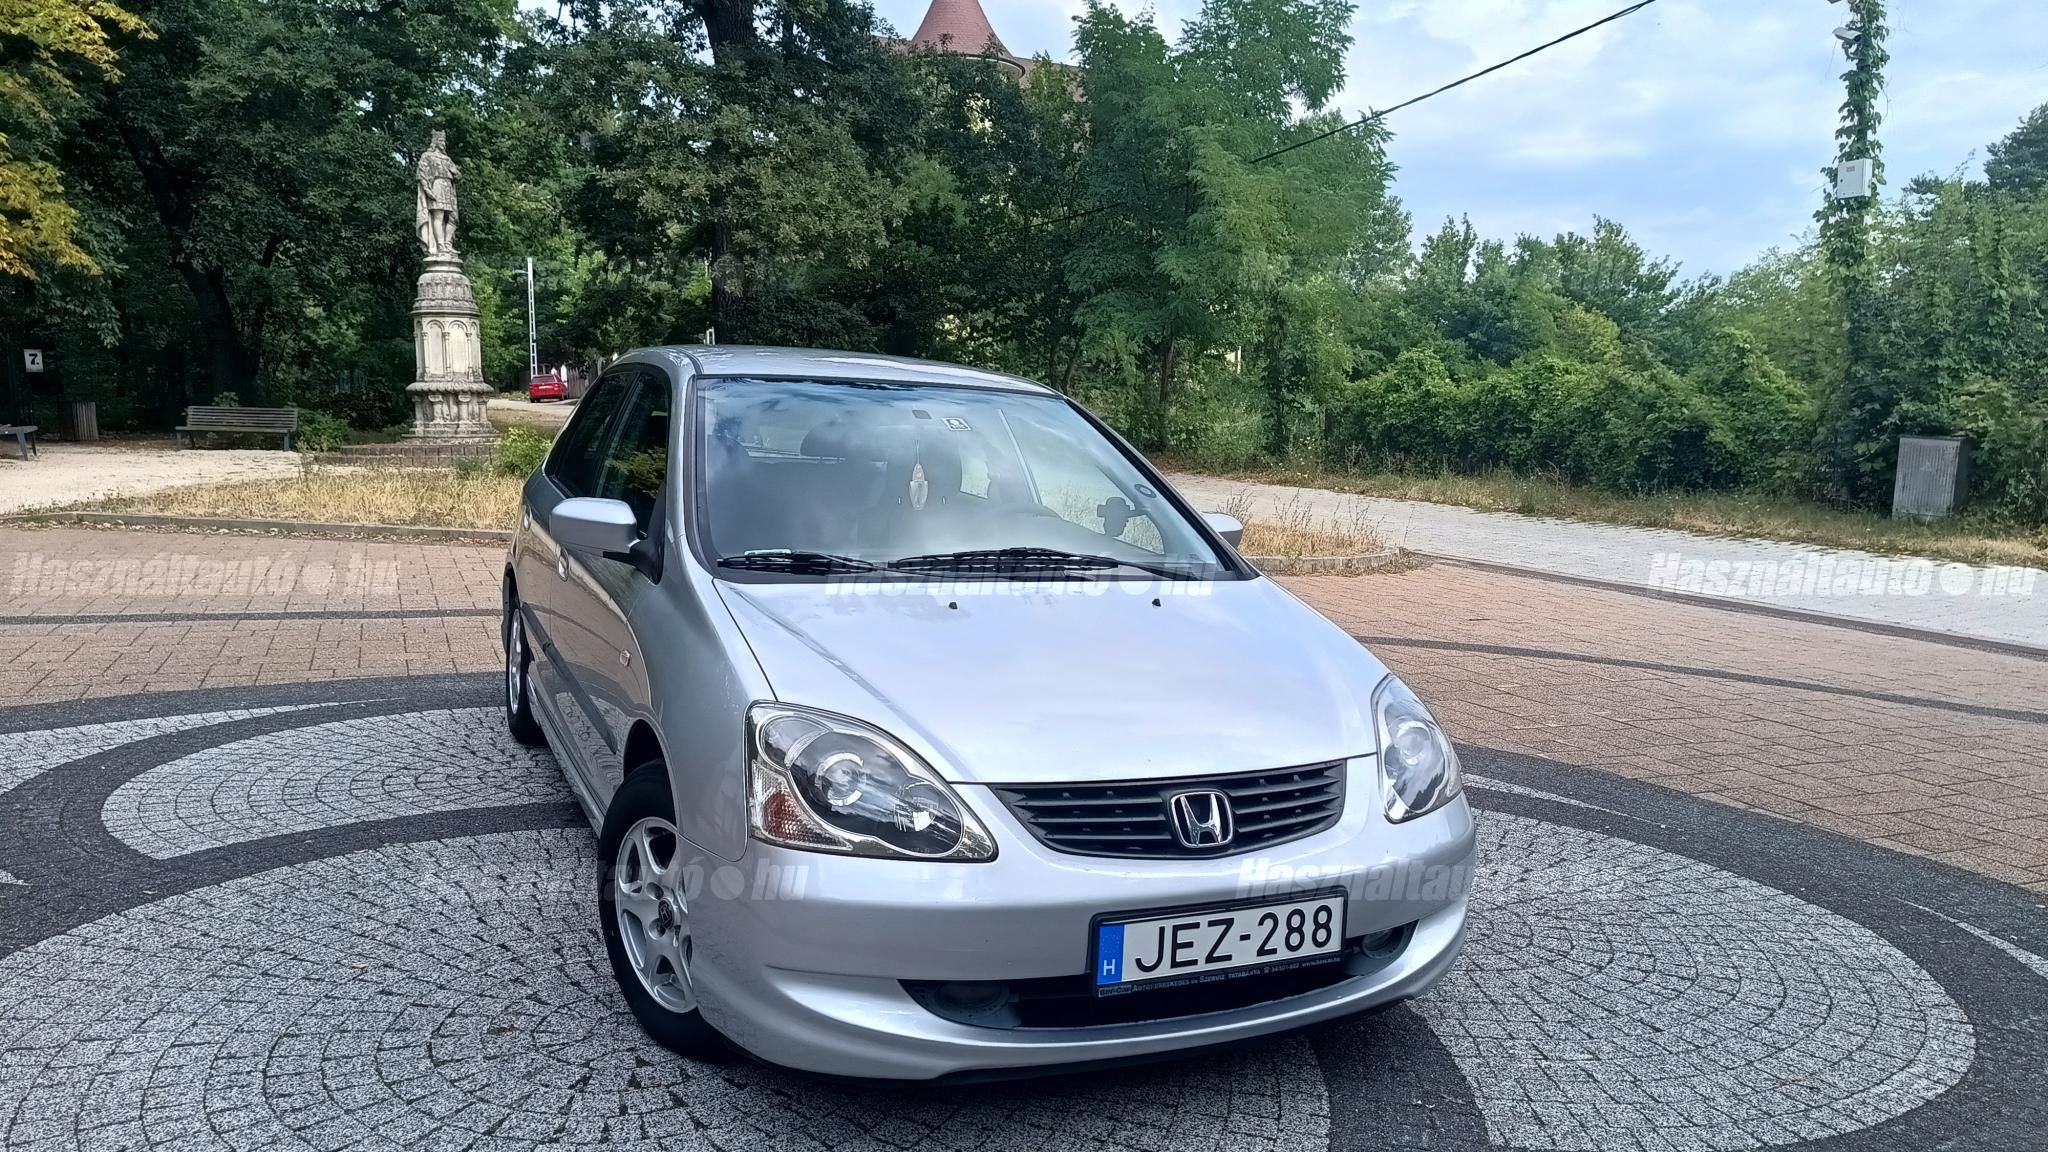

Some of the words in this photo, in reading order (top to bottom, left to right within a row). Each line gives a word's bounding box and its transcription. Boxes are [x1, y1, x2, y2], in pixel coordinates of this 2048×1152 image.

[29, 353, 40, 366] 7.
[1135, 904, 1333, 973] JEZ-288
[1103, 958, 1116, 976] H
